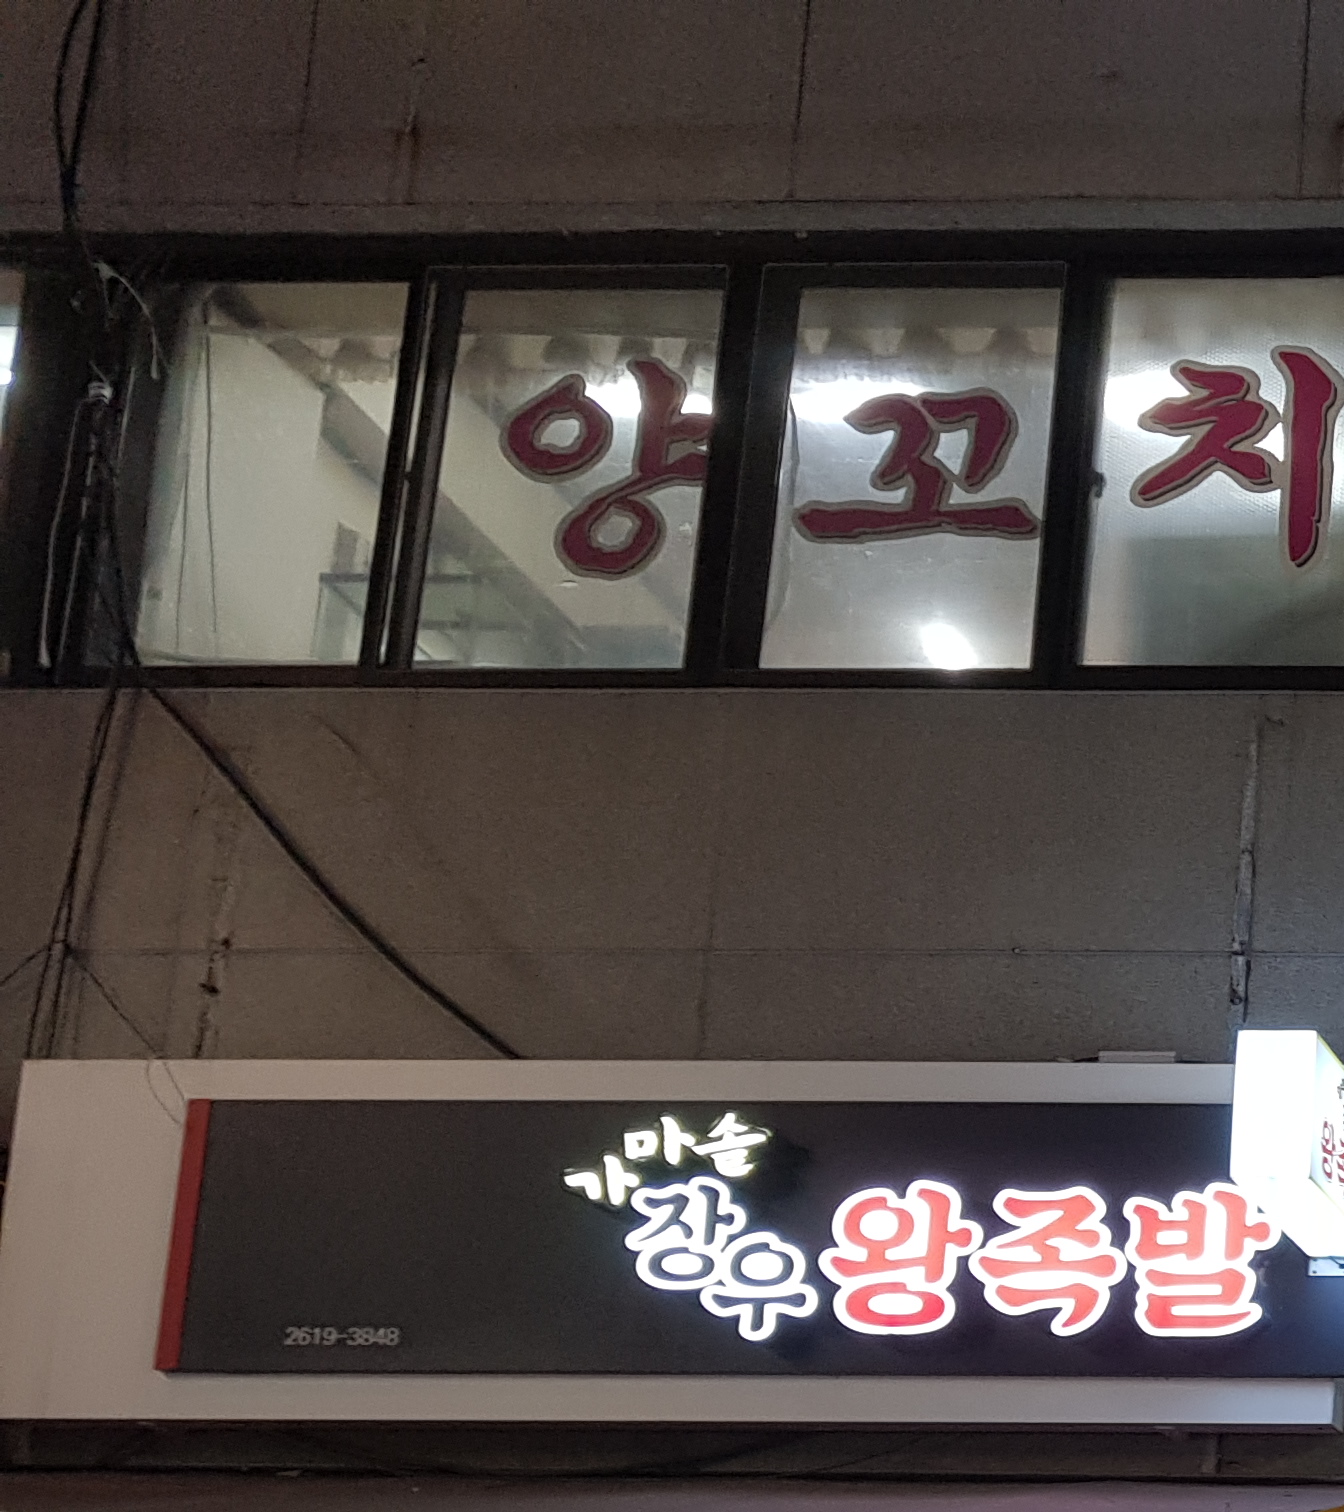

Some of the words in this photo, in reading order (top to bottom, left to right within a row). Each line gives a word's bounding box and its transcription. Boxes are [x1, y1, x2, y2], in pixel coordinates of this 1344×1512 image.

[625, 1176, 818, 1341] 장우
[819, 1180, 1281, 1338] 왕족발
[283, 1326, 400, 1347] 2619-3848
